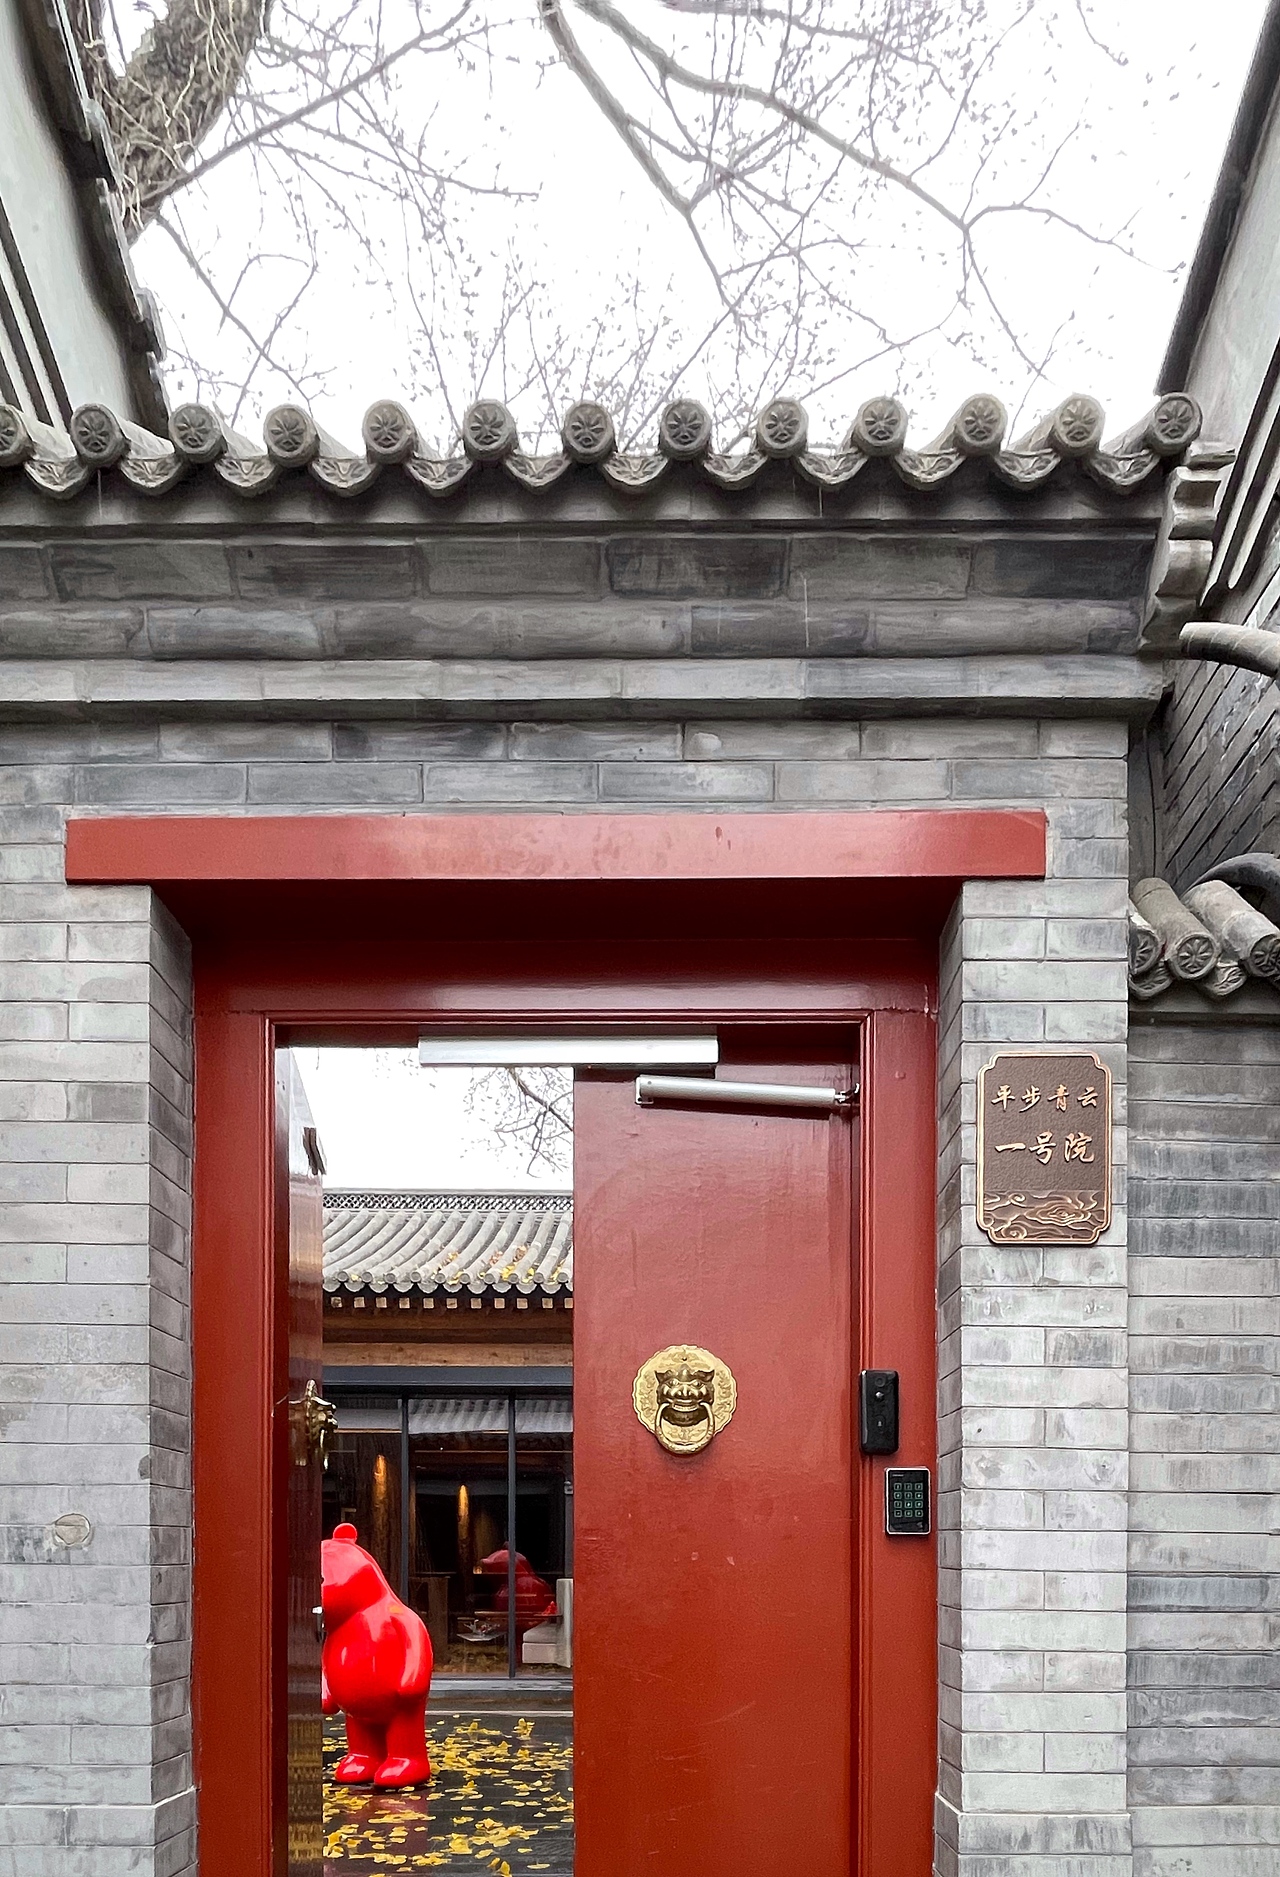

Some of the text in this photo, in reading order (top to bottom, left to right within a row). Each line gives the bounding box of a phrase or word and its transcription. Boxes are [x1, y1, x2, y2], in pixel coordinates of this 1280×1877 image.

[991, 1084, 1098, 1113] 平步青云
[995, 1129, 1095, 1164] 一号院
